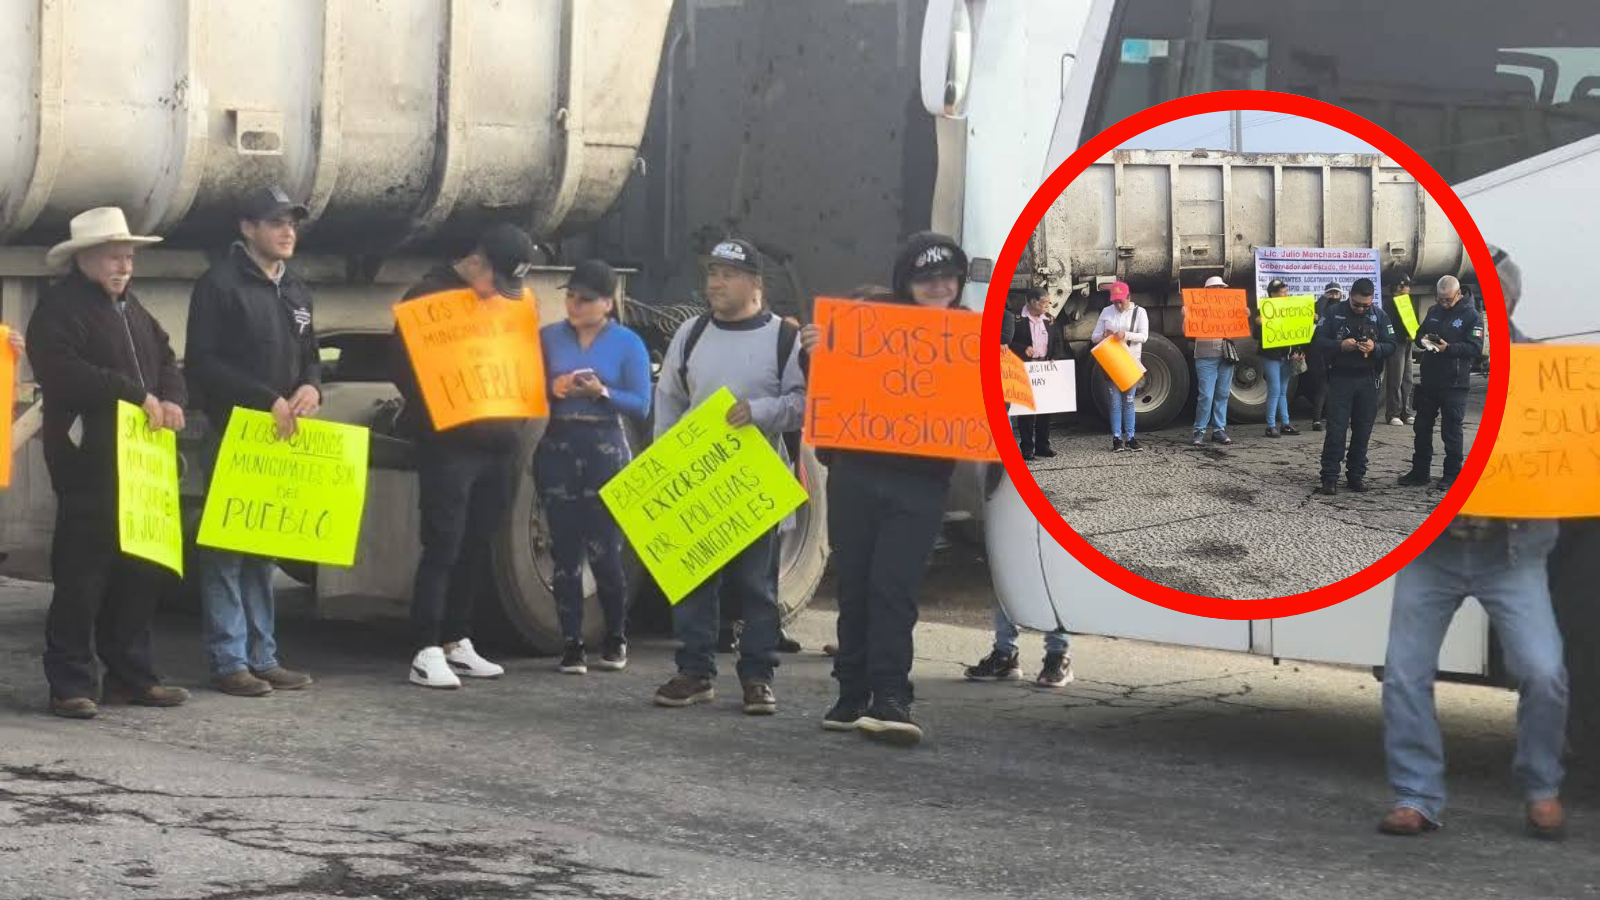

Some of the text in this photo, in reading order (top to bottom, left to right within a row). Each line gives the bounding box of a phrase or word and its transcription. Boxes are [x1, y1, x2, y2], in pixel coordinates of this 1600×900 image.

[1264, 250, 1279, 258] Lic.
[1302, 251, 1340, 259] Menchaca
[1342, 251, 1372, 259] Salazar.
[1259, 262, 1300, 270] Gobernador
[1190, 290, 1241, 306] Estamos
[1227, 307, 1242, 319] de
[1262, 301, 1314, 320] Queremos
[1188, 321, 1199, 333] la
[883, 358, 936, 398] de
[1031, 377, 1046, 387] HAY
[809, 396, 993, 453] Extorsiones
[611, 421, 708, 510] BASTA DE
[642, 433, 742, 521] EXTORSIONES
[222, 497, 332, 539] PUEBLO
